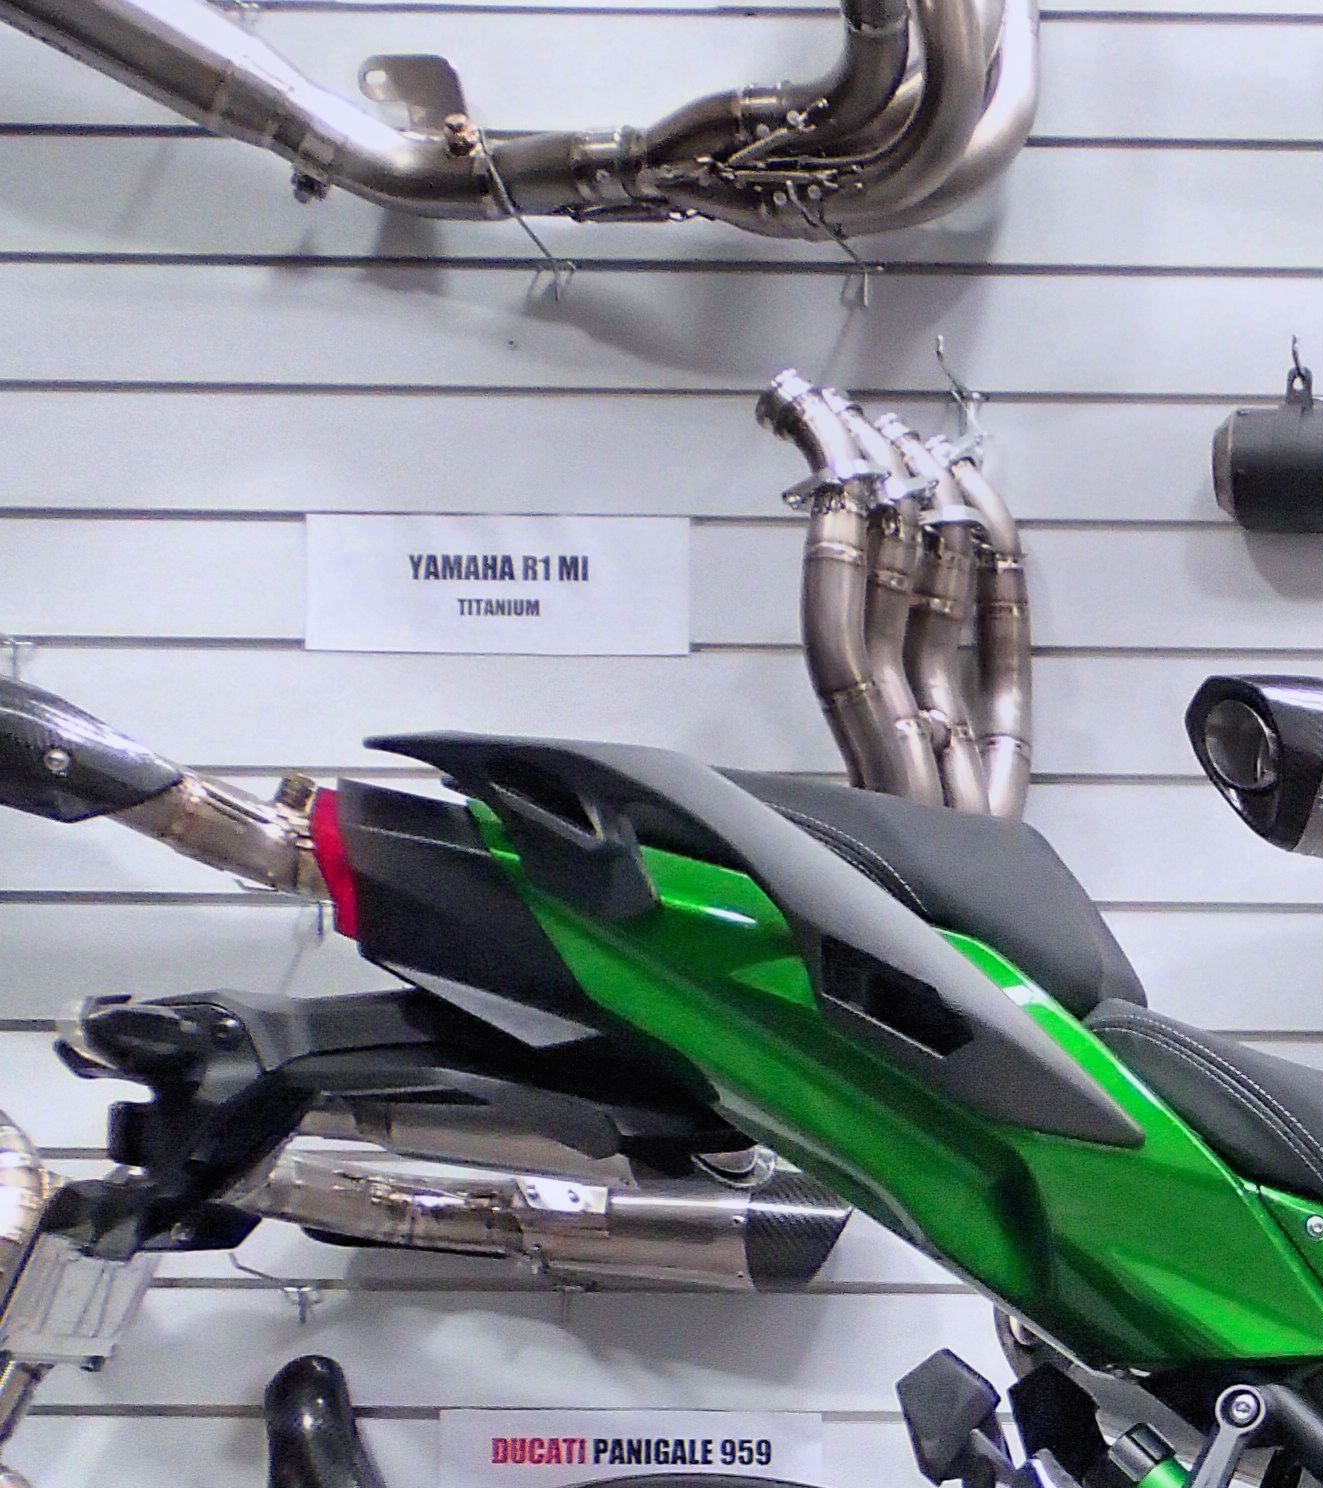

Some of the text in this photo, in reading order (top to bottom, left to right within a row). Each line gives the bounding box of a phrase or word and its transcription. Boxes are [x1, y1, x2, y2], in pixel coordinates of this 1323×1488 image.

[409, 554, 515, 581] YAMAHA
[522, 555, 551, 581] R1
[457, 598, 540, 617] TITANIUM
[491, 1438, 772, 1466] DUCATI PANIGALE 959
